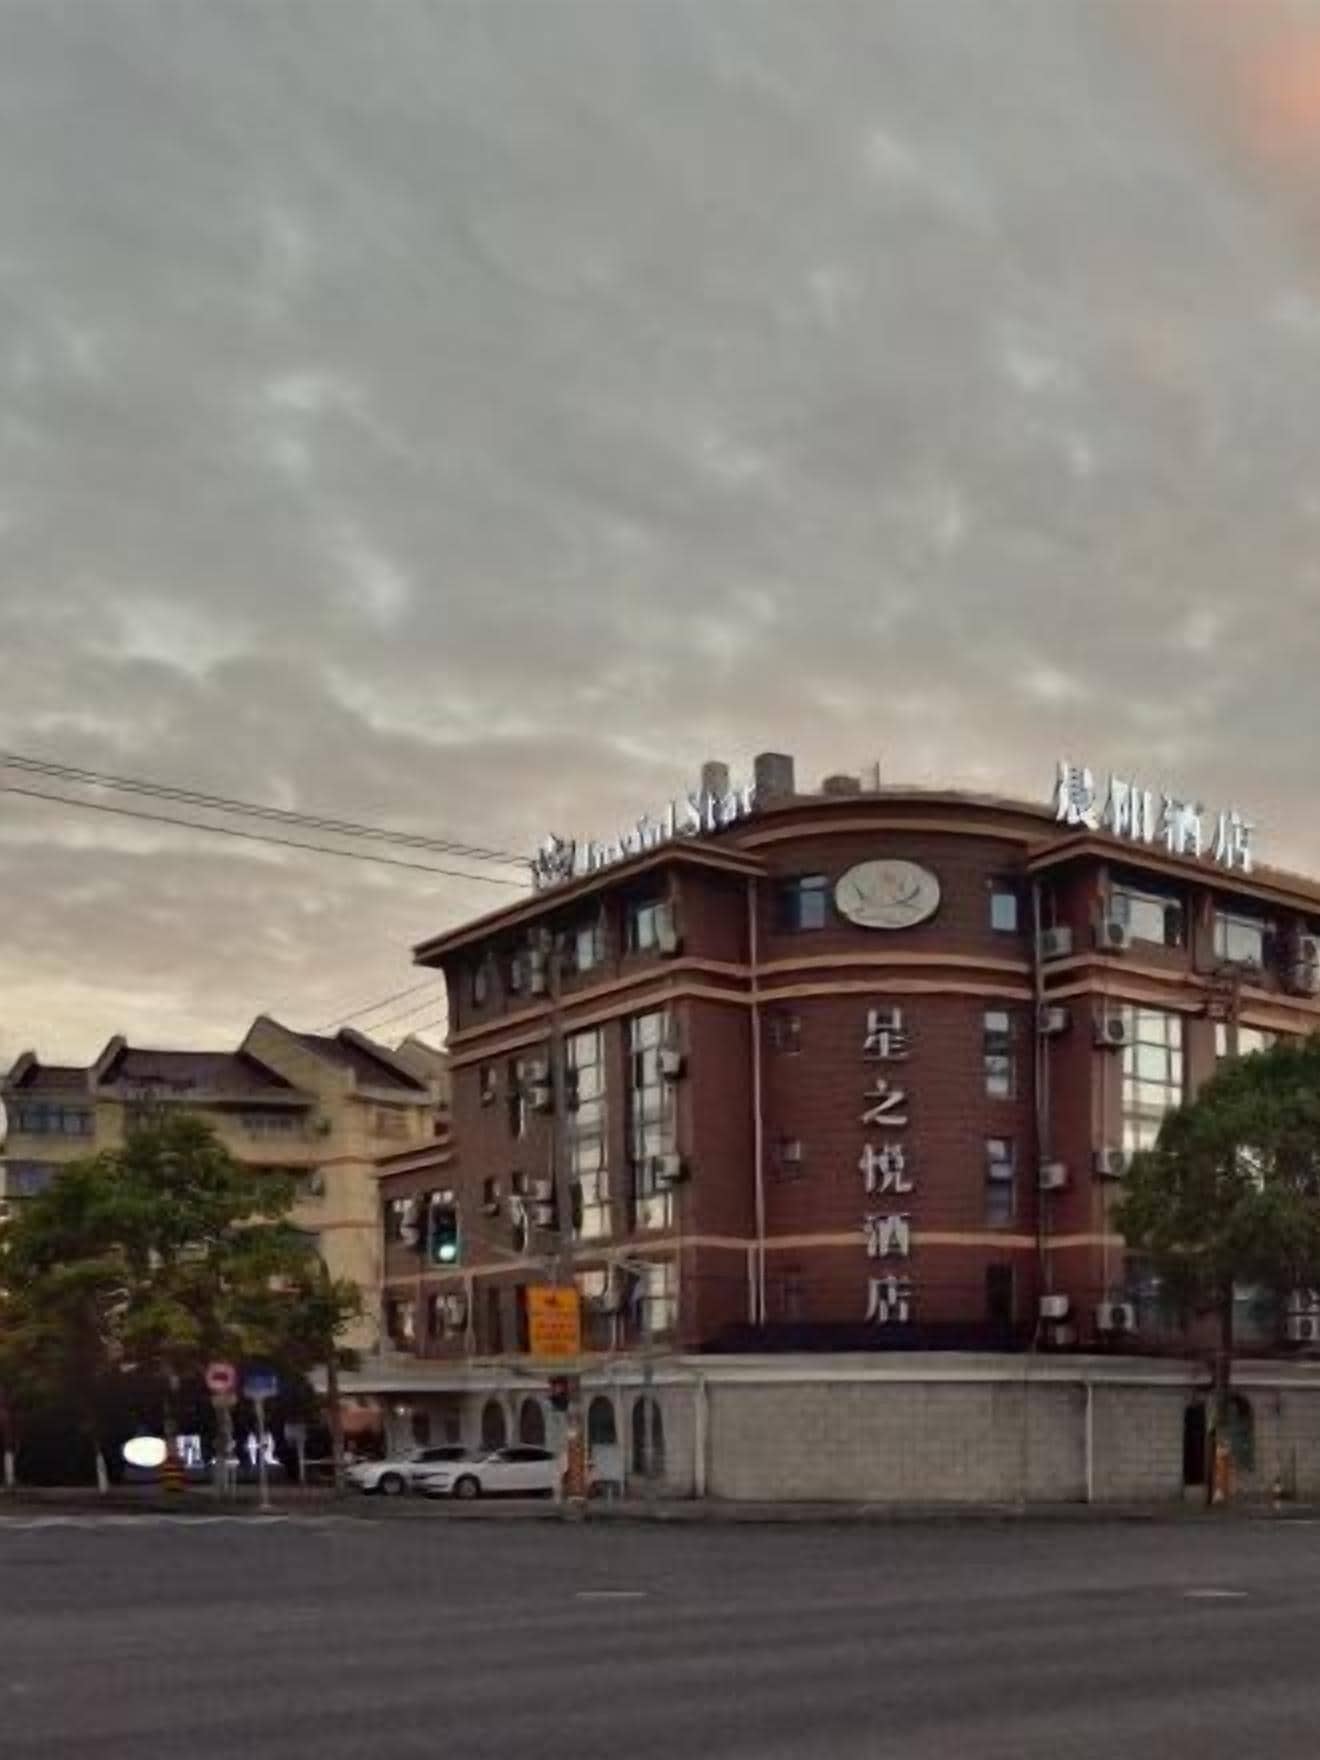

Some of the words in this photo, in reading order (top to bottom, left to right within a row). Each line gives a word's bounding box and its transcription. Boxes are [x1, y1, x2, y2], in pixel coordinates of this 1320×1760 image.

[861, 1008, 912, 1322] 星之悦酒店
